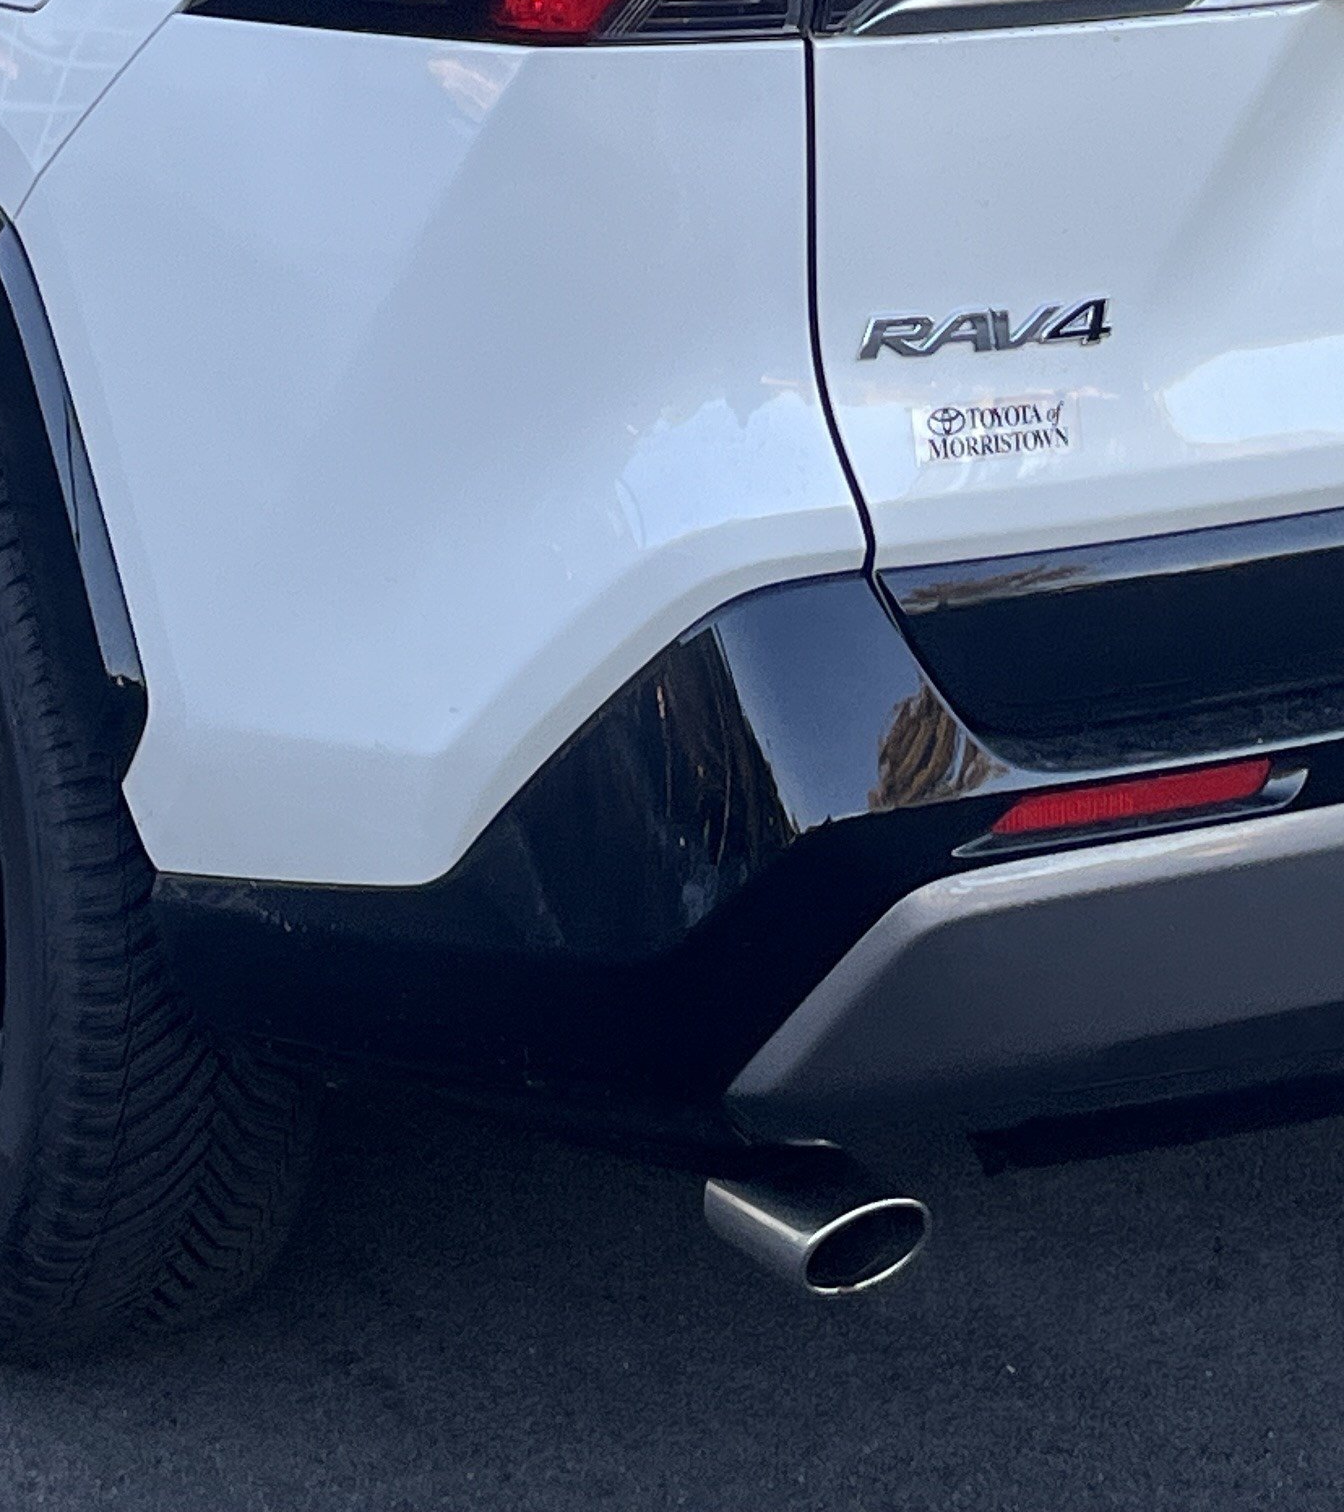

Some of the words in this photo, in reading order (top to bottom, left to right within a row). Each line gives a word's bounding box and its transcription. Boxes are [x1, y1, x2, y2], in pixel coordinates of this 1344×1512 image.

[857, 294, 1113, 360] RAV4
[964, 404, 1042, 429] TOYOTA
[1045, 400, 1065, 426] of
[927, 426, 1070, 462] MORRISTOWN
